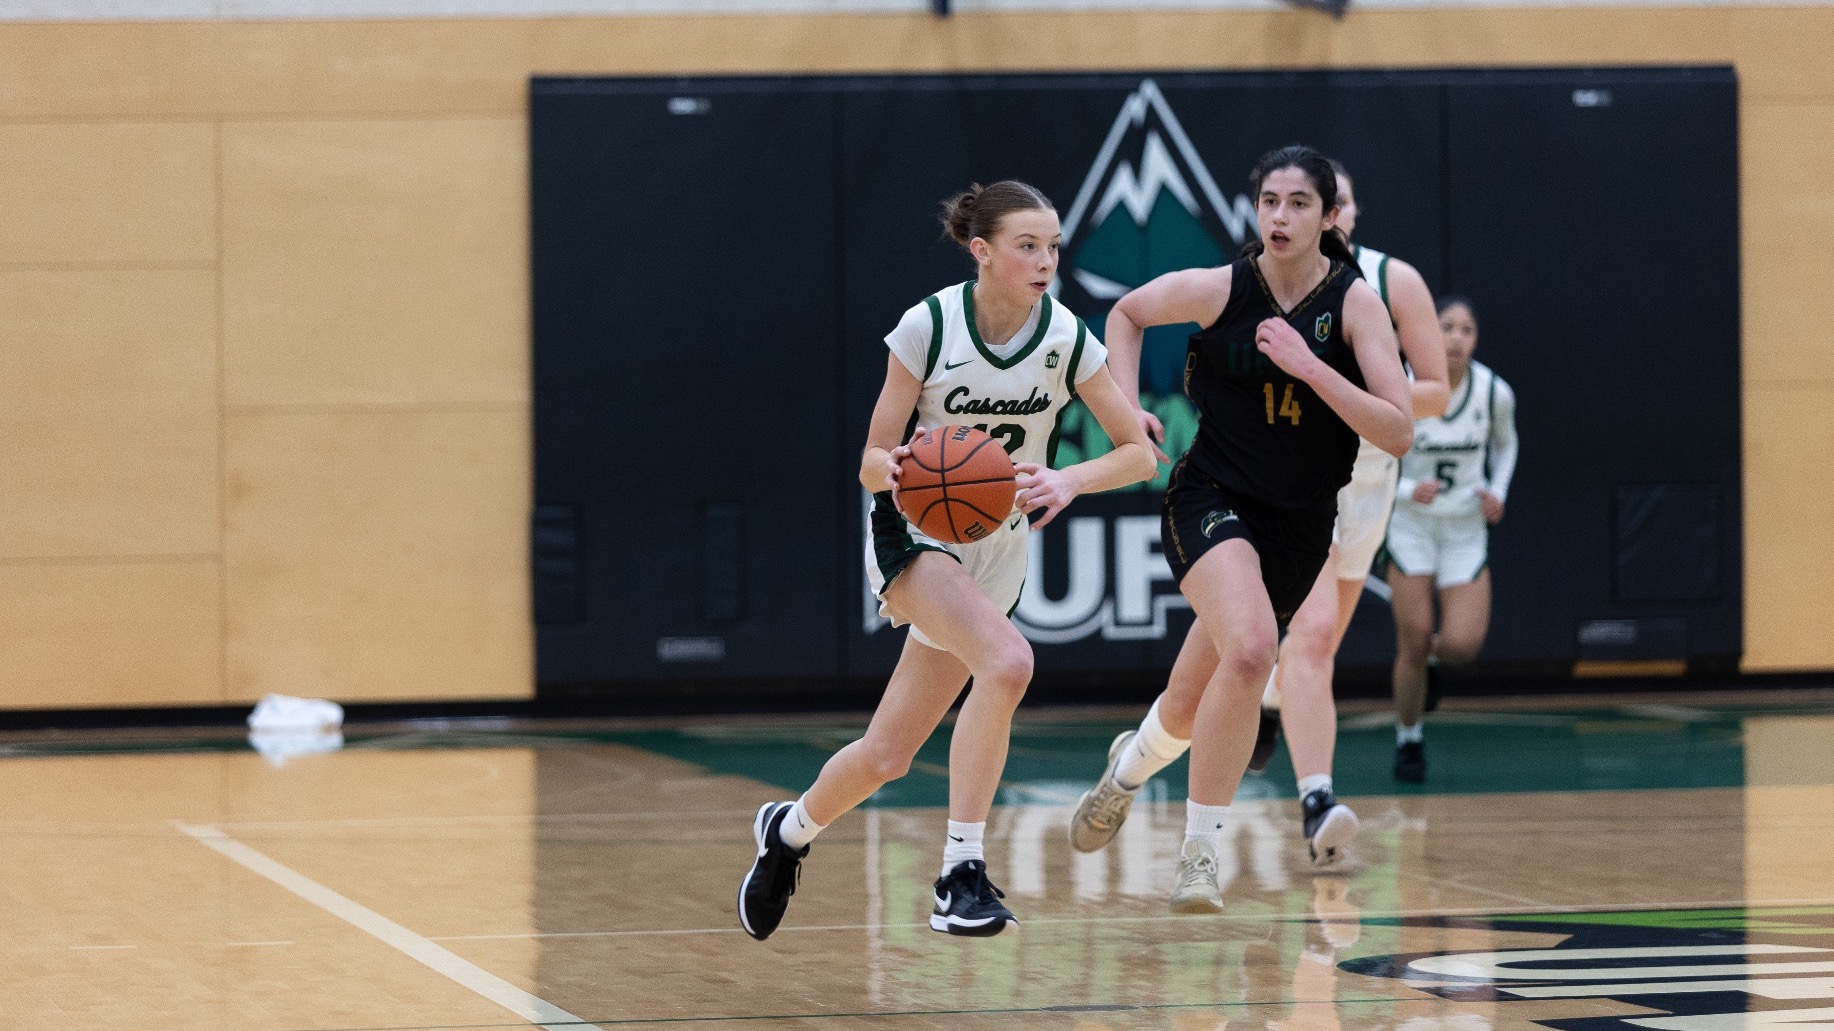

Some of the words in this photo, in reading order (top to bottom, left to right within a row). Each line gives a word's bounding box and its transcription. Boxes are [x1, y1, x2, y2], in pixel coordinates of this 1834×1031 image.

[943, 386, 1052, 416] Cascades
[1263, 382, 1302, 426] 14
[1436, 461, 1458, 495] 5
